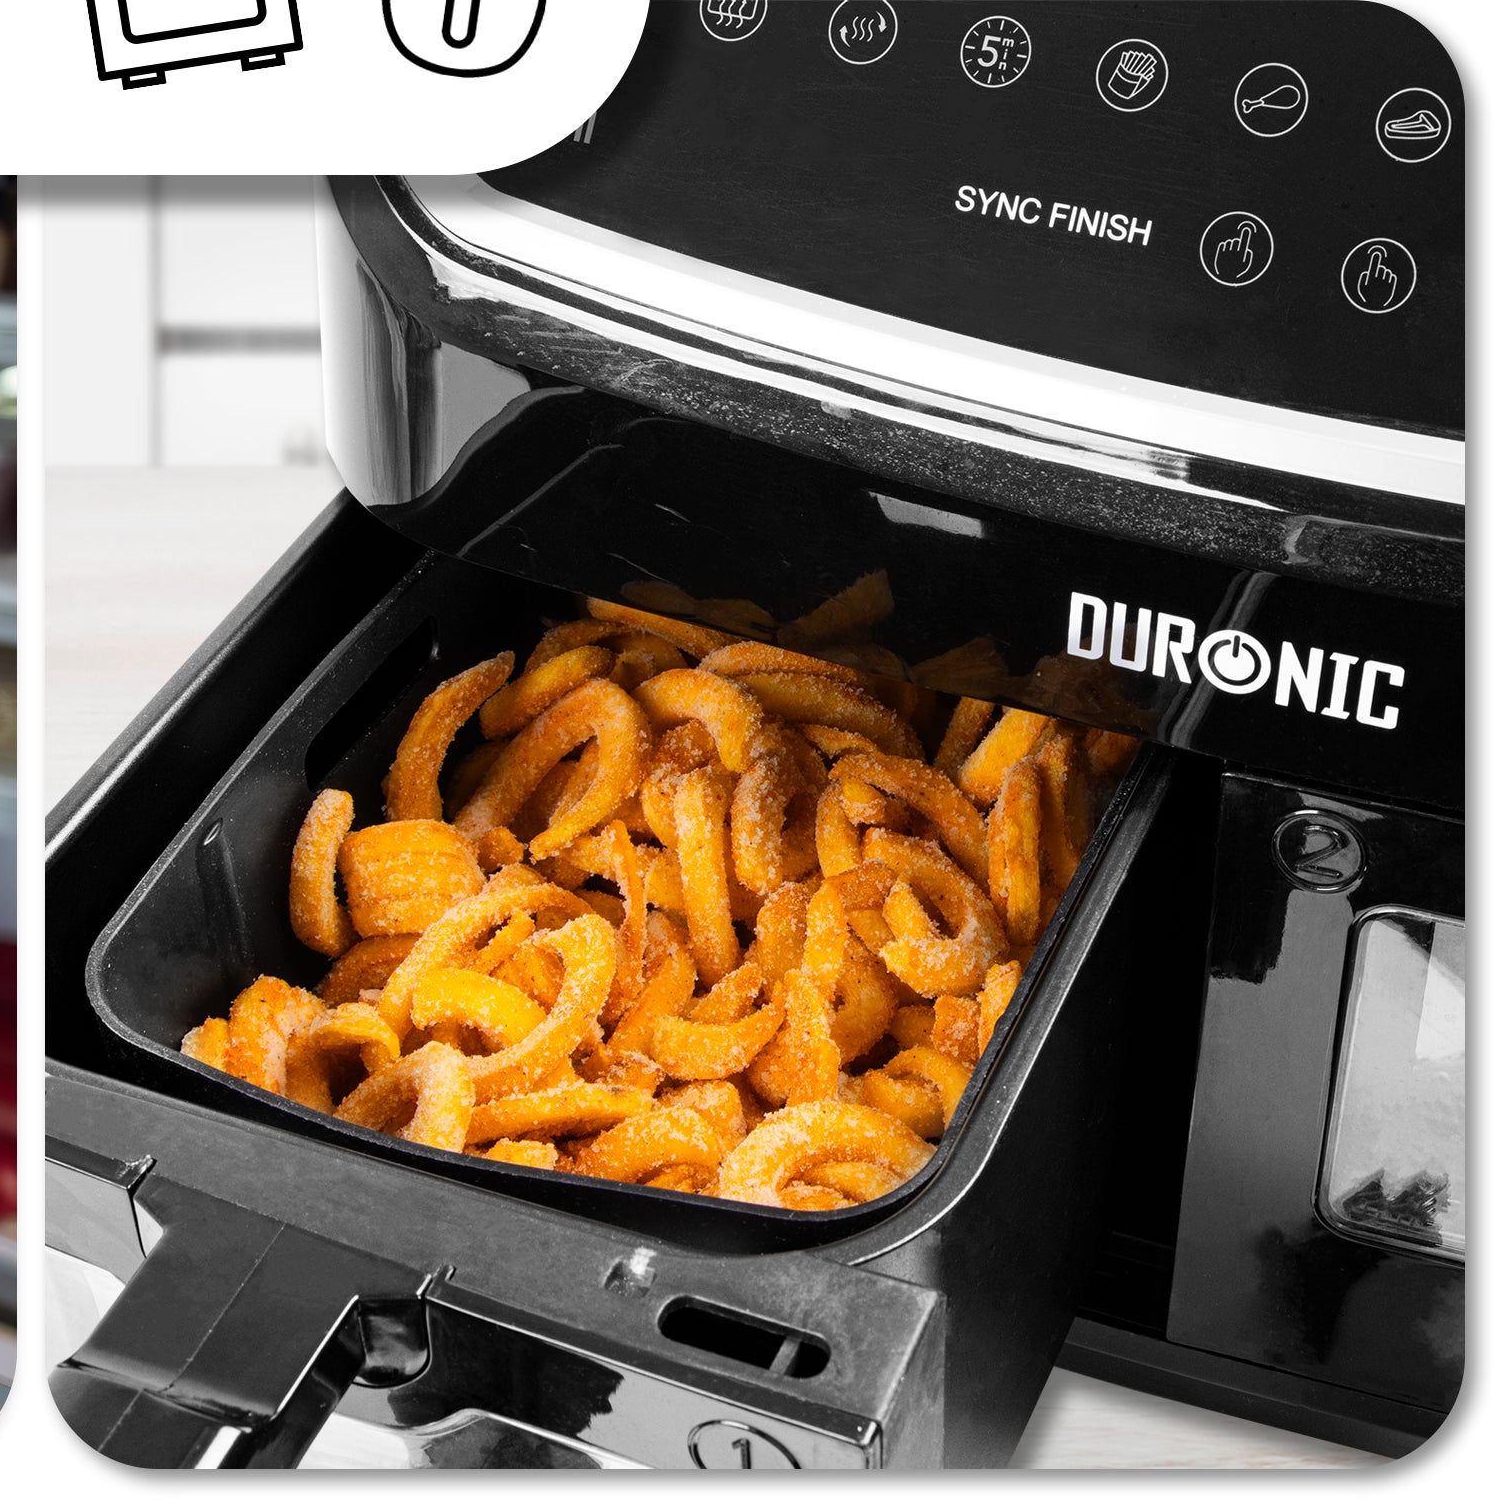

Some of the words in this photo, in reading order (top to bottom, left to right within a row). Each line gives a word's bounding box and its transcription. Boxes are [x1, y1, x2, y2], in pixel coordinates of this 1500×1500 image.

[977, 35, 1001, 68] 5
[955, 185, 1042, 224] SYNC
[1049, 202, 1153, 246] FINISH
[1066, 591, 1406, 730] DURONIC
[1297, 824, 1344, 879] 2
